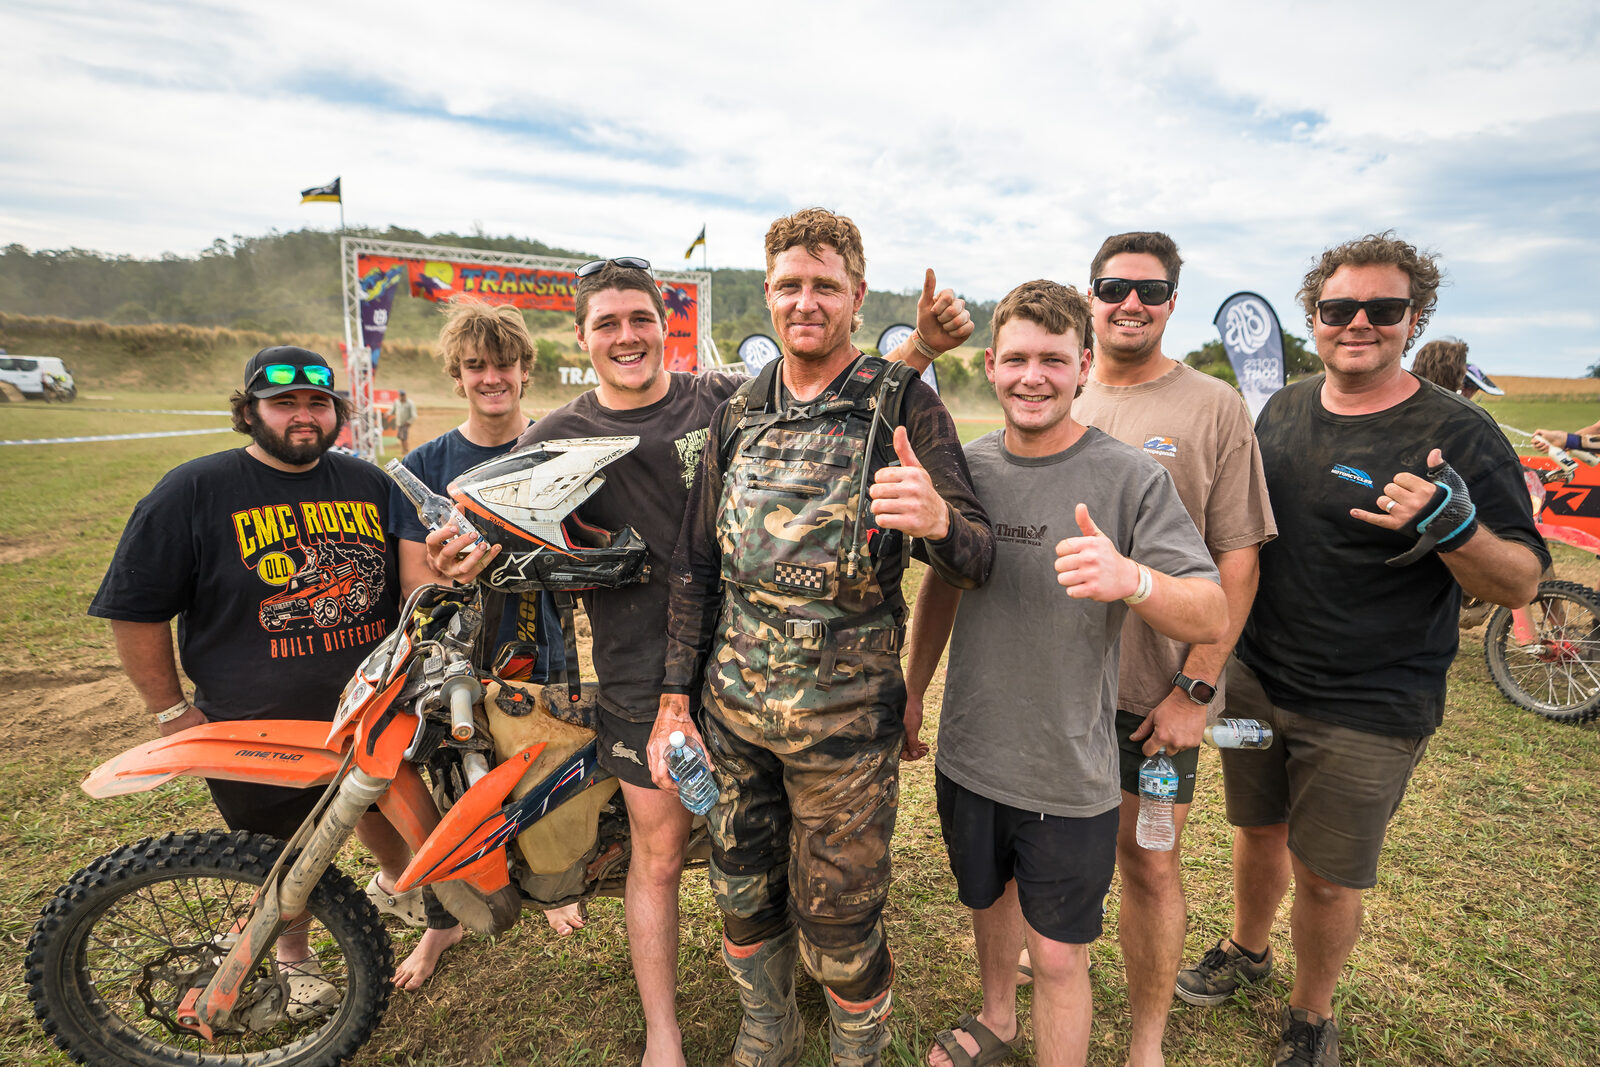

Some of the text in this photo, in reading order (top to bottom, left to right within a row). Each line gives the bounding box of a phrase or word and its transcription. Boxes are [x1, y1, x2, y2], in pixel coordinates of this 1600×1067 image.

[558, 366, 599, 385] TRA
[232, 502, 386, 564] CMC ROCKS
[995, 523, 1034, 539] Thrills
[265, 557, 289, 579] QLD
[270, 618, 388, 659] BUILT DIFFERENT
